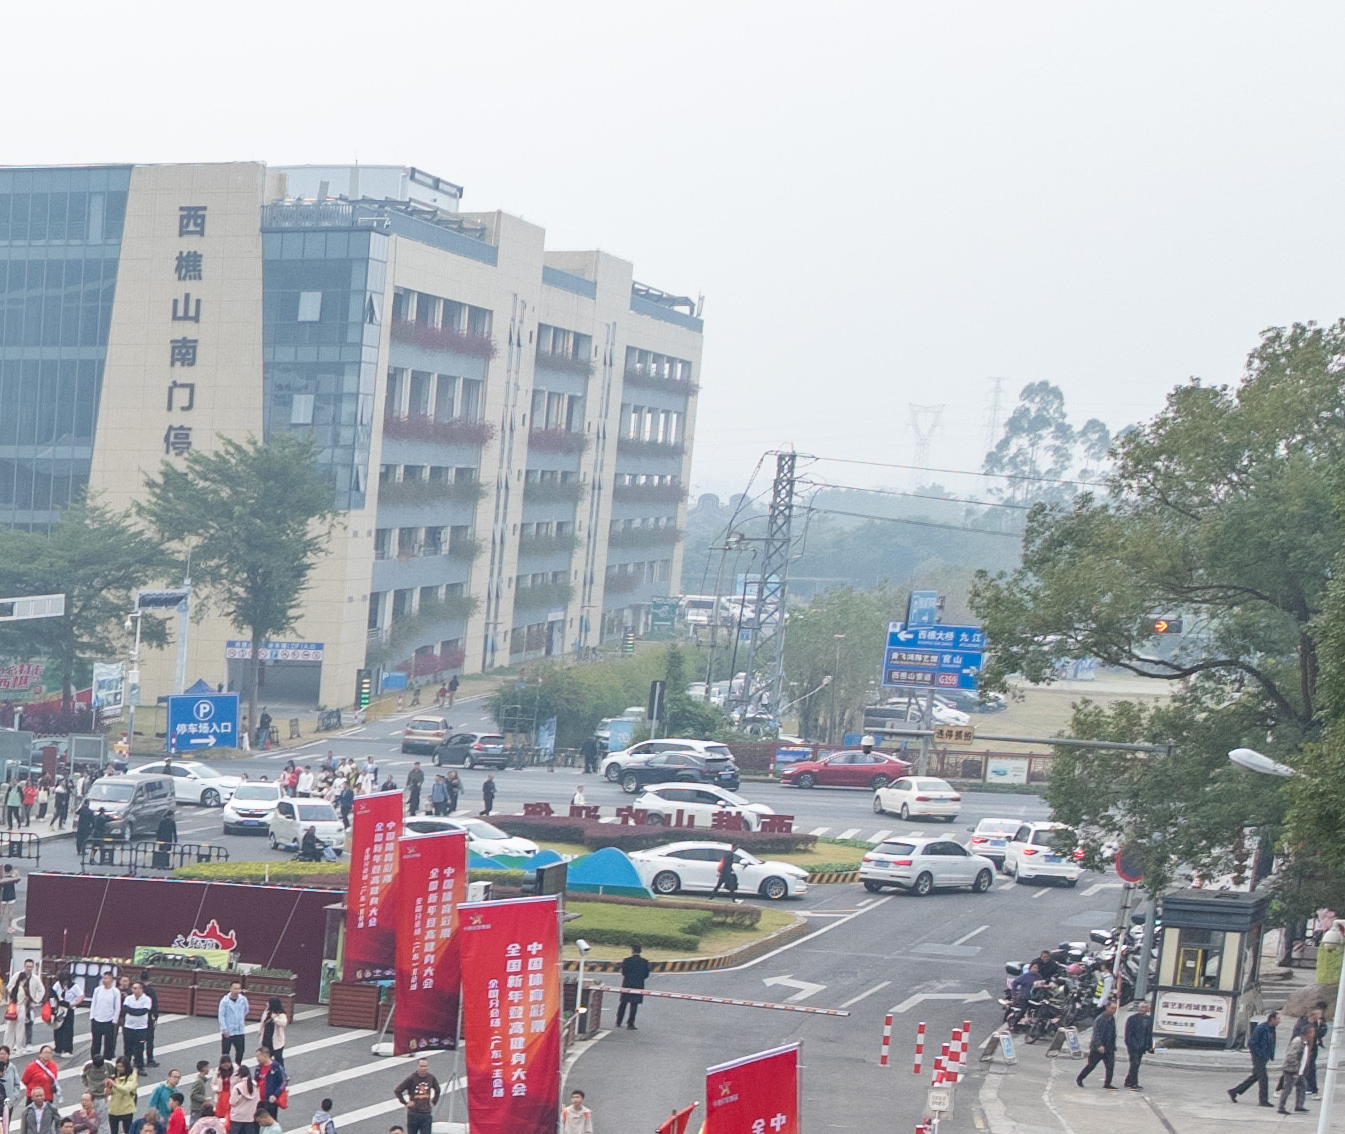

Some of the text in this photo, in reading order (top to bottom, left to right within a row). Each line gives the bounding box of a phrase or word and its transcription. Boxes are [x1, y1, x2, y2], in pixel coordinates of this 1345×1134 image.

[163, 206, 208, 456] 西樵山南门停
[175, 722, 232, 735] 停车场入口
